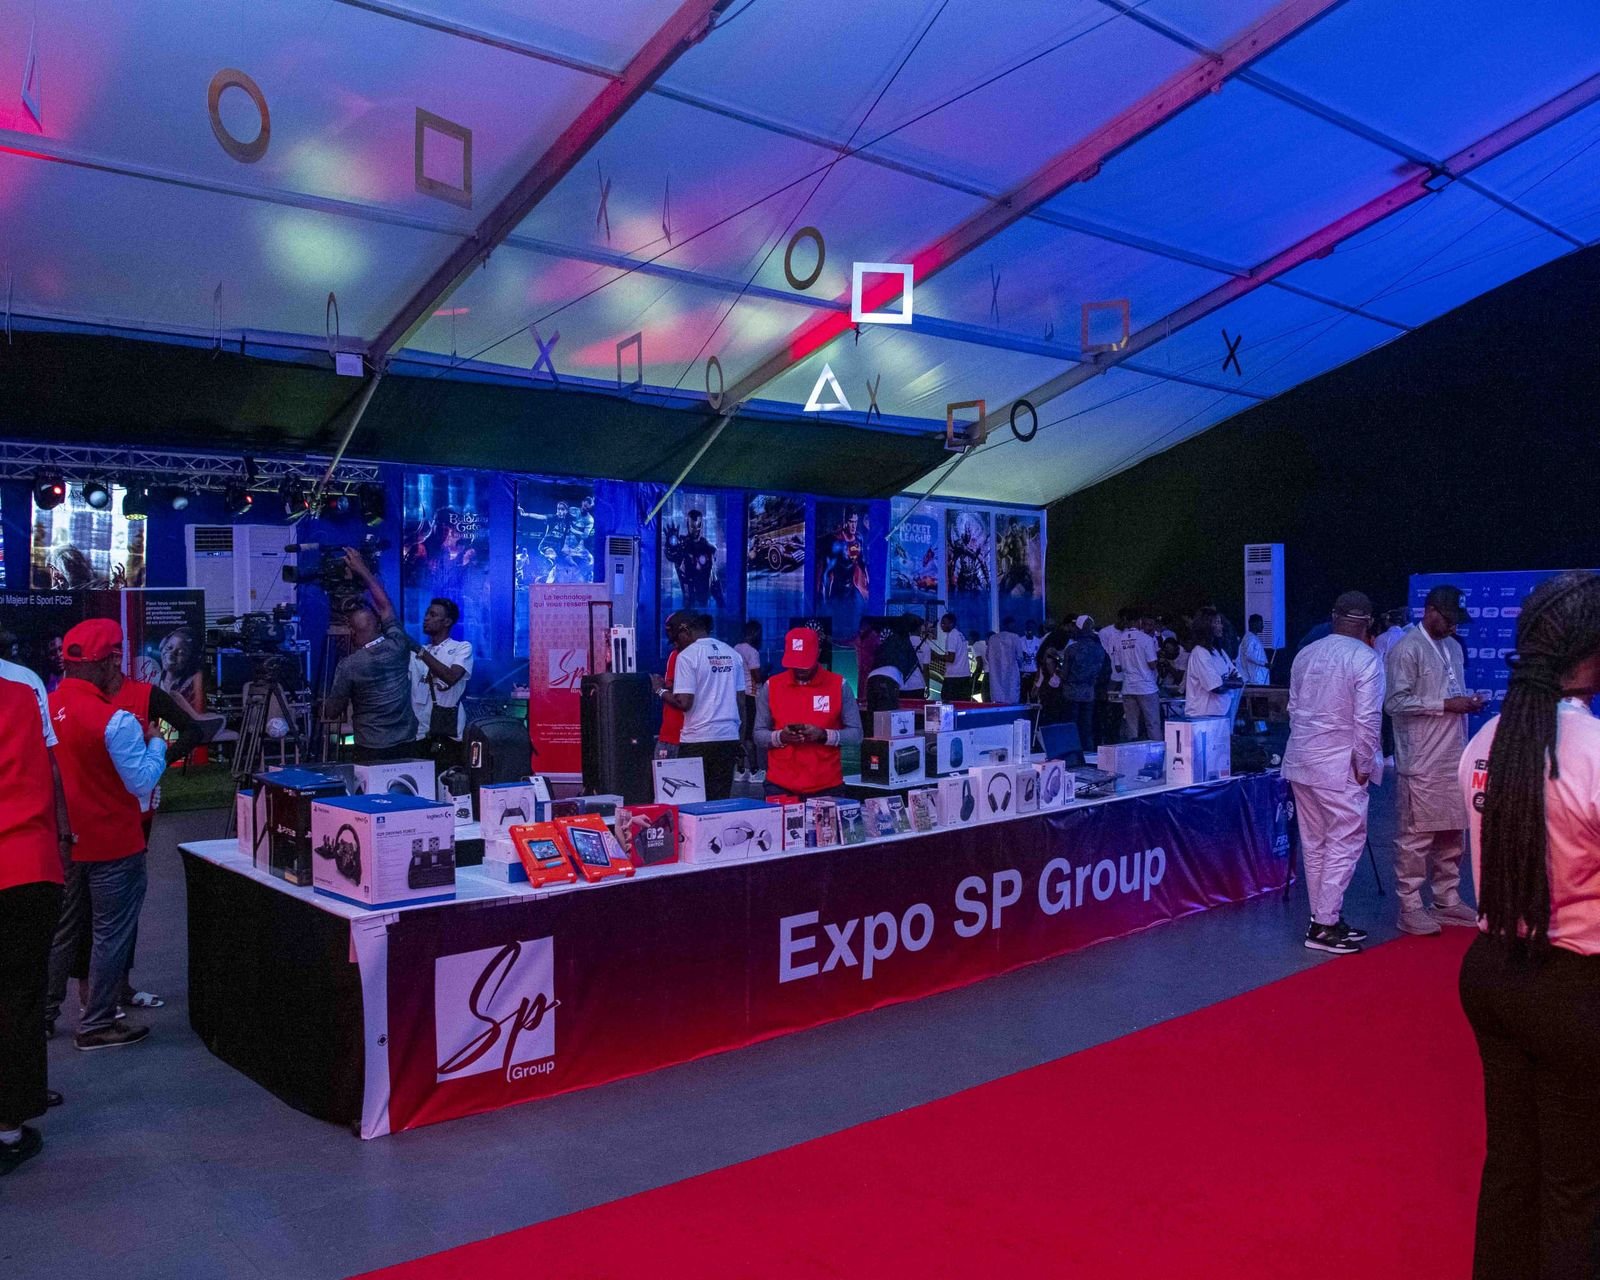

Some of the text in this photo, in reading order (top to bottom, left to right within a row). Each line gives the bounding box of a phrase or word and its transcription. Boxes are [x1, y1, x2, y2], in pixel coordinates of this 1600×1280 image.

[900, 522, 931, 534] ROCKET
[900, 533, 931, 544] LEAGUE
[5, 594, 28, 606] Majeur
[30, 594, 35, 605] E
[36, 594, 54, 606] Sport
[55, 595, 73, 605] FC25
[553, 593, 592, 602] technologie
[779, 847, 1167, 984] Expo SP Group
[512, 1060, 555, 1080] Group
